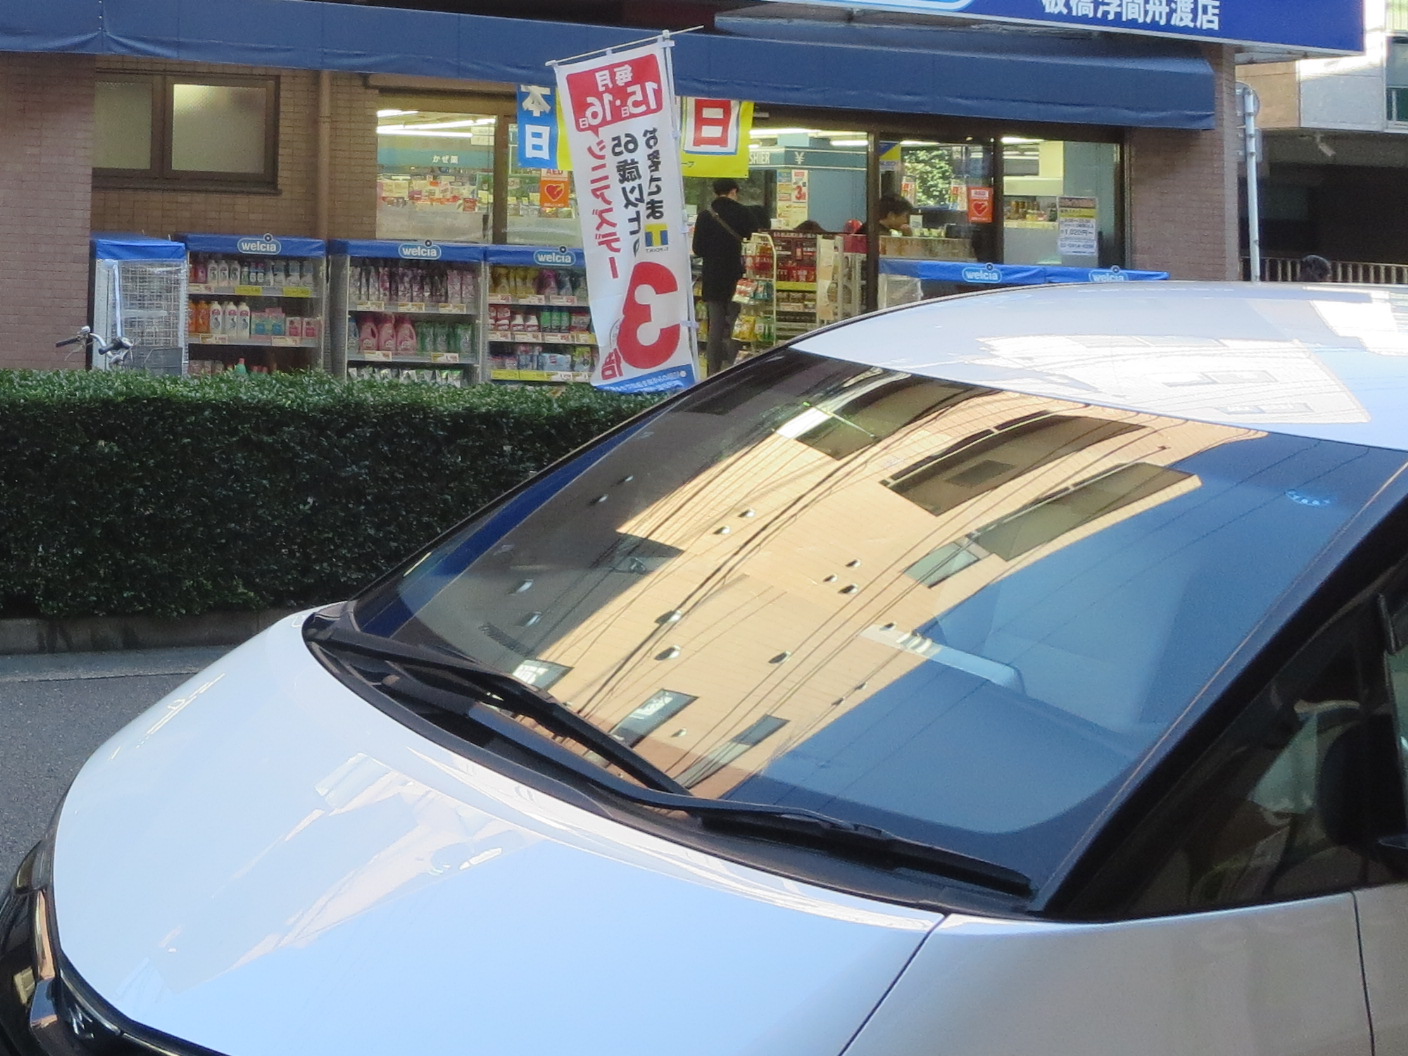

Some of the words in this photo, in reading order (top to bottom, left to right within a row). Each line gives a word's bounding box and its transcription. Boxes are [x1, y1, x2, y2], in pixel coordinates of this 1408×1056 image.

[432, 154, 459, 164] かぜ薬
[749, 151, 771, 164] SHIER
[241, 241, 277, 252] welcia
[402, 246, 437, 257] welcia
[537, 252, 572, 263] welcia
[965, 269, 999, 281] welcia
